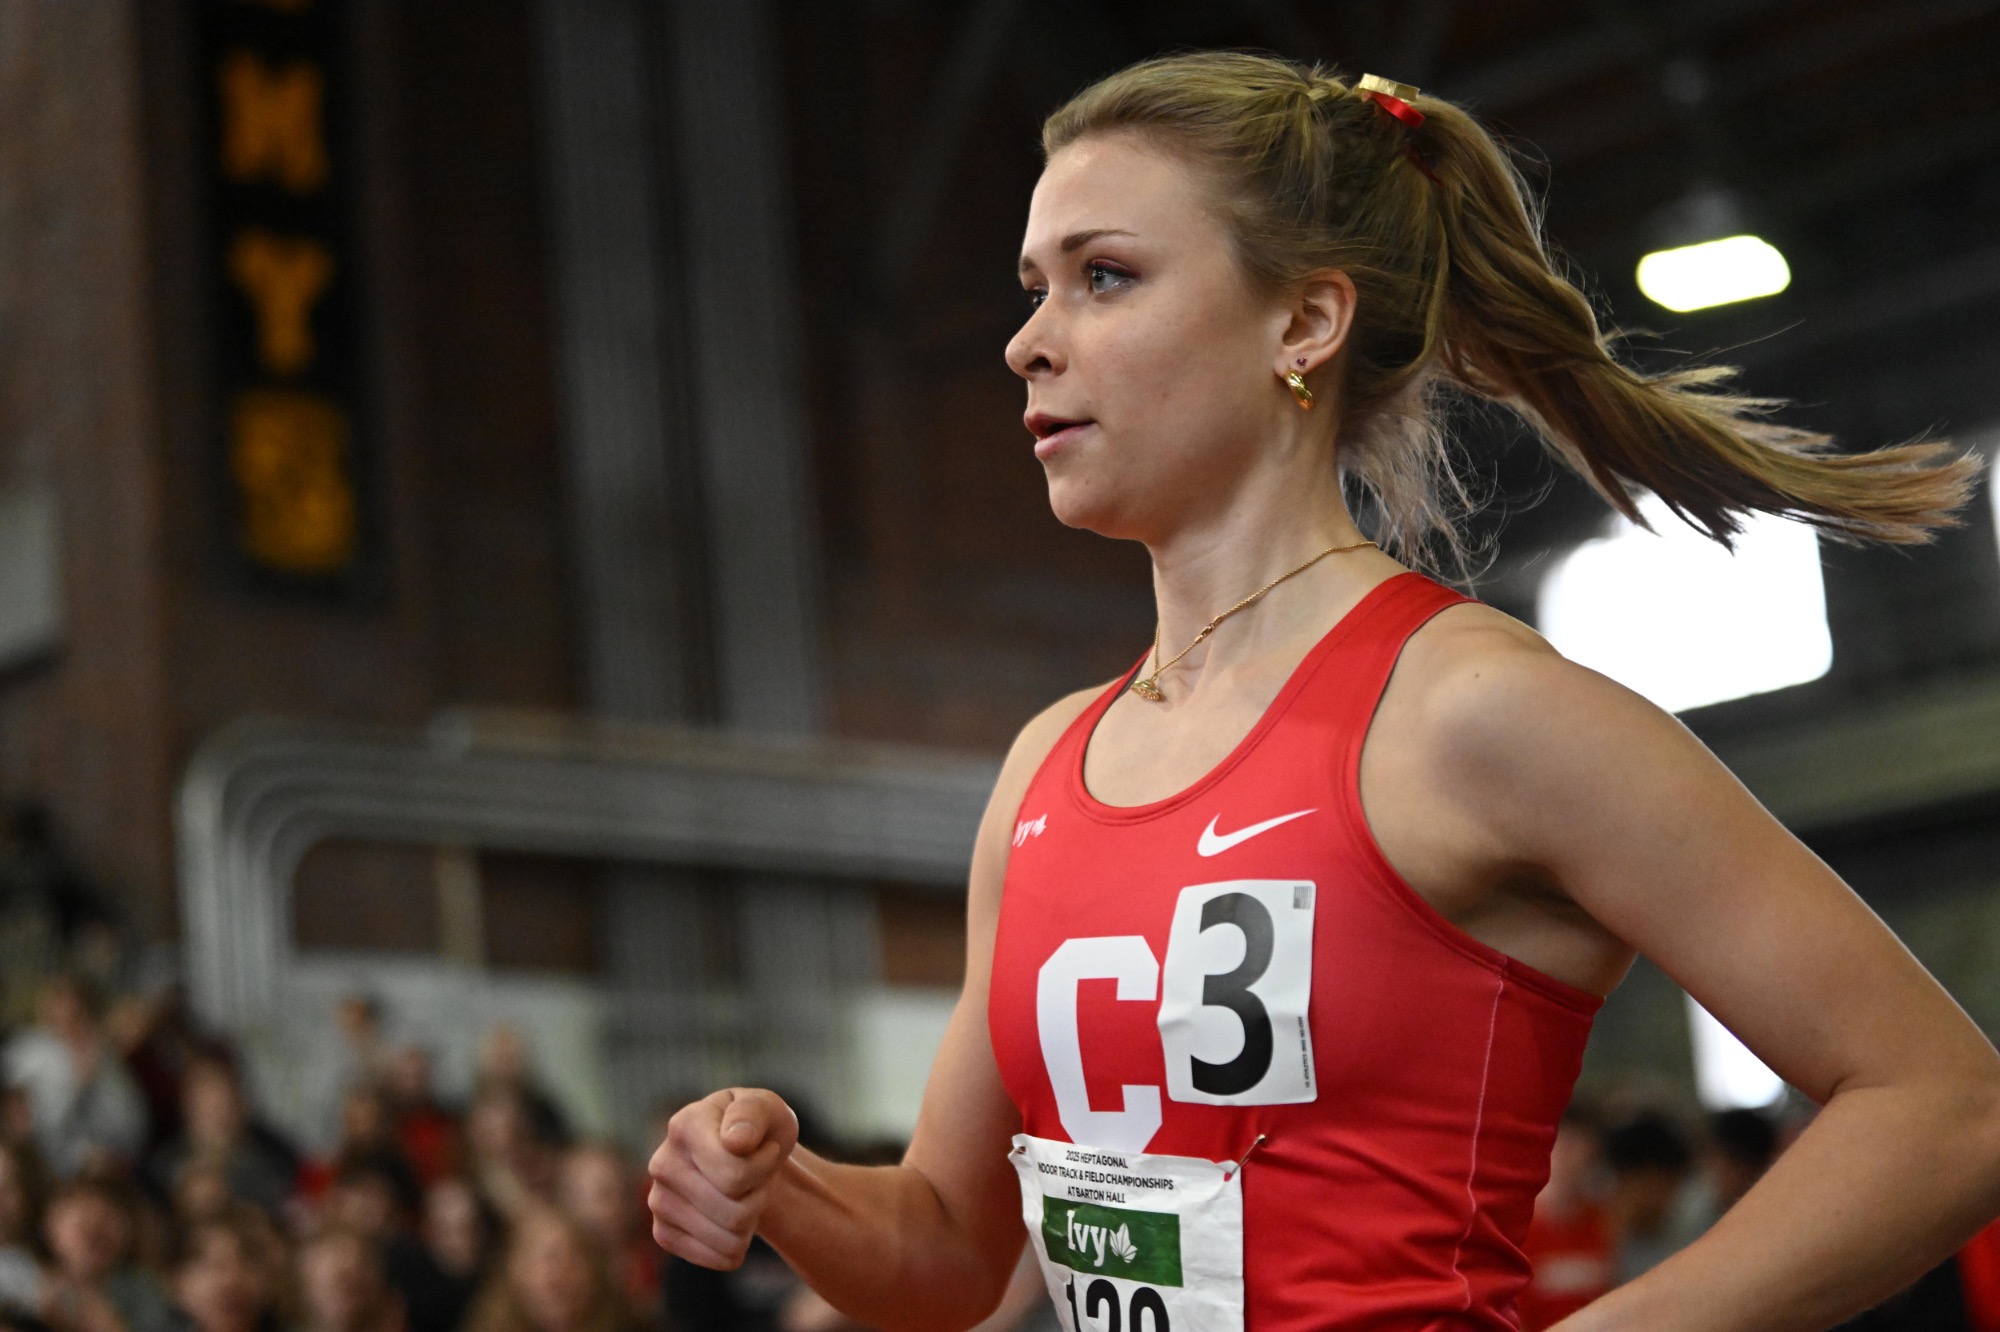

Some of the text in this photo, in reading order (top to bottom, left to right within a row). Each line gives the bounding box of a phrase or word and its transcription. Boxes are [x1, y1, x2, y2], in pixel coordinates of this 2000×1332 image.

[1190, 892, 1275, 1097] 3
[1036, 935, 1163, 1154] C
[1037, 1162, 1175, 1190] NDOOR TRACK & FIELD CHAMPIONSHIPS
[1066, 1150, 1129, 1169] 2025 HEPTAGONAL
[1067, 1185, 1126, 1204] AT BARTON HALL
[1066, 1209, 1108, 1268] Ivy
